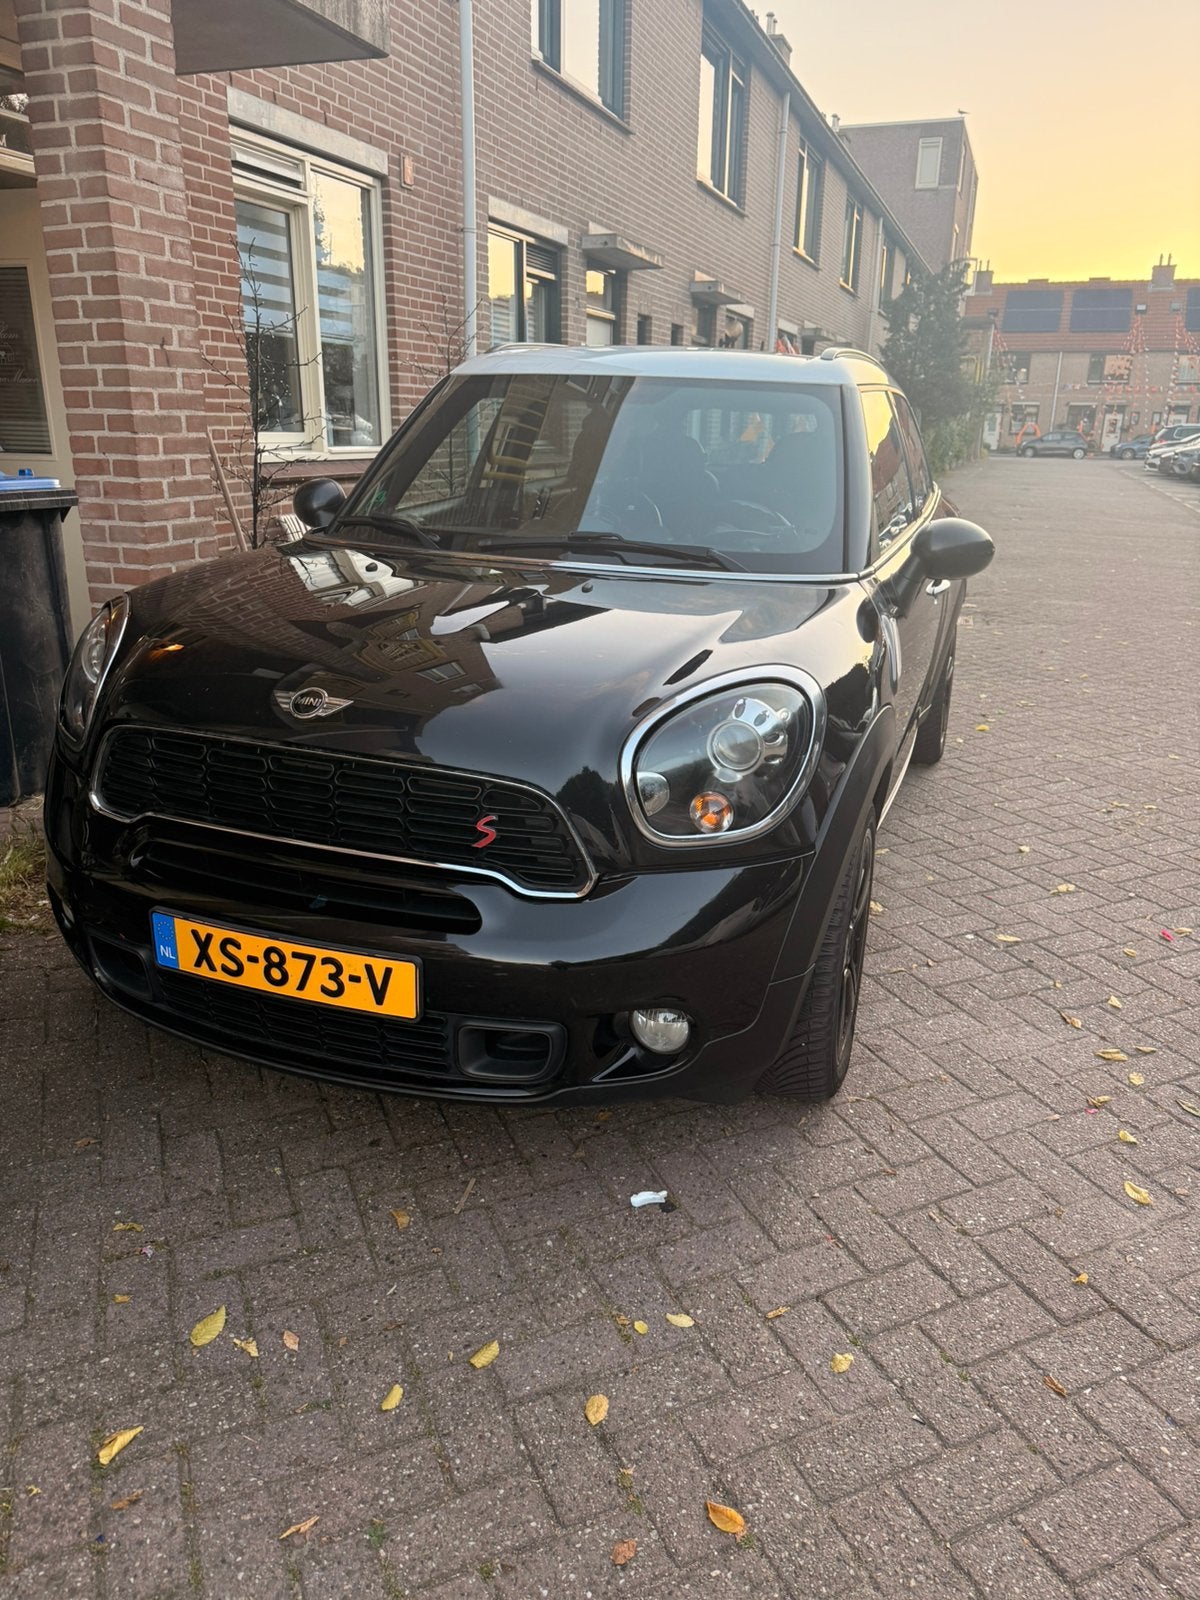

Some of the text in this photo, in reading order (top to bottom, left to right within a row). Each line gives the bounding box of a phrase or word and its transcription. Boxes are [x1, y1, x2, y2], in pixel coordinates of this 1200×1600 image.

[295, 696, 322, 708] MINI
[471, 815, 498, 849] S
[159, 944, 176, 960] NL
[190, 928, 394, 1007] XS-873-V
